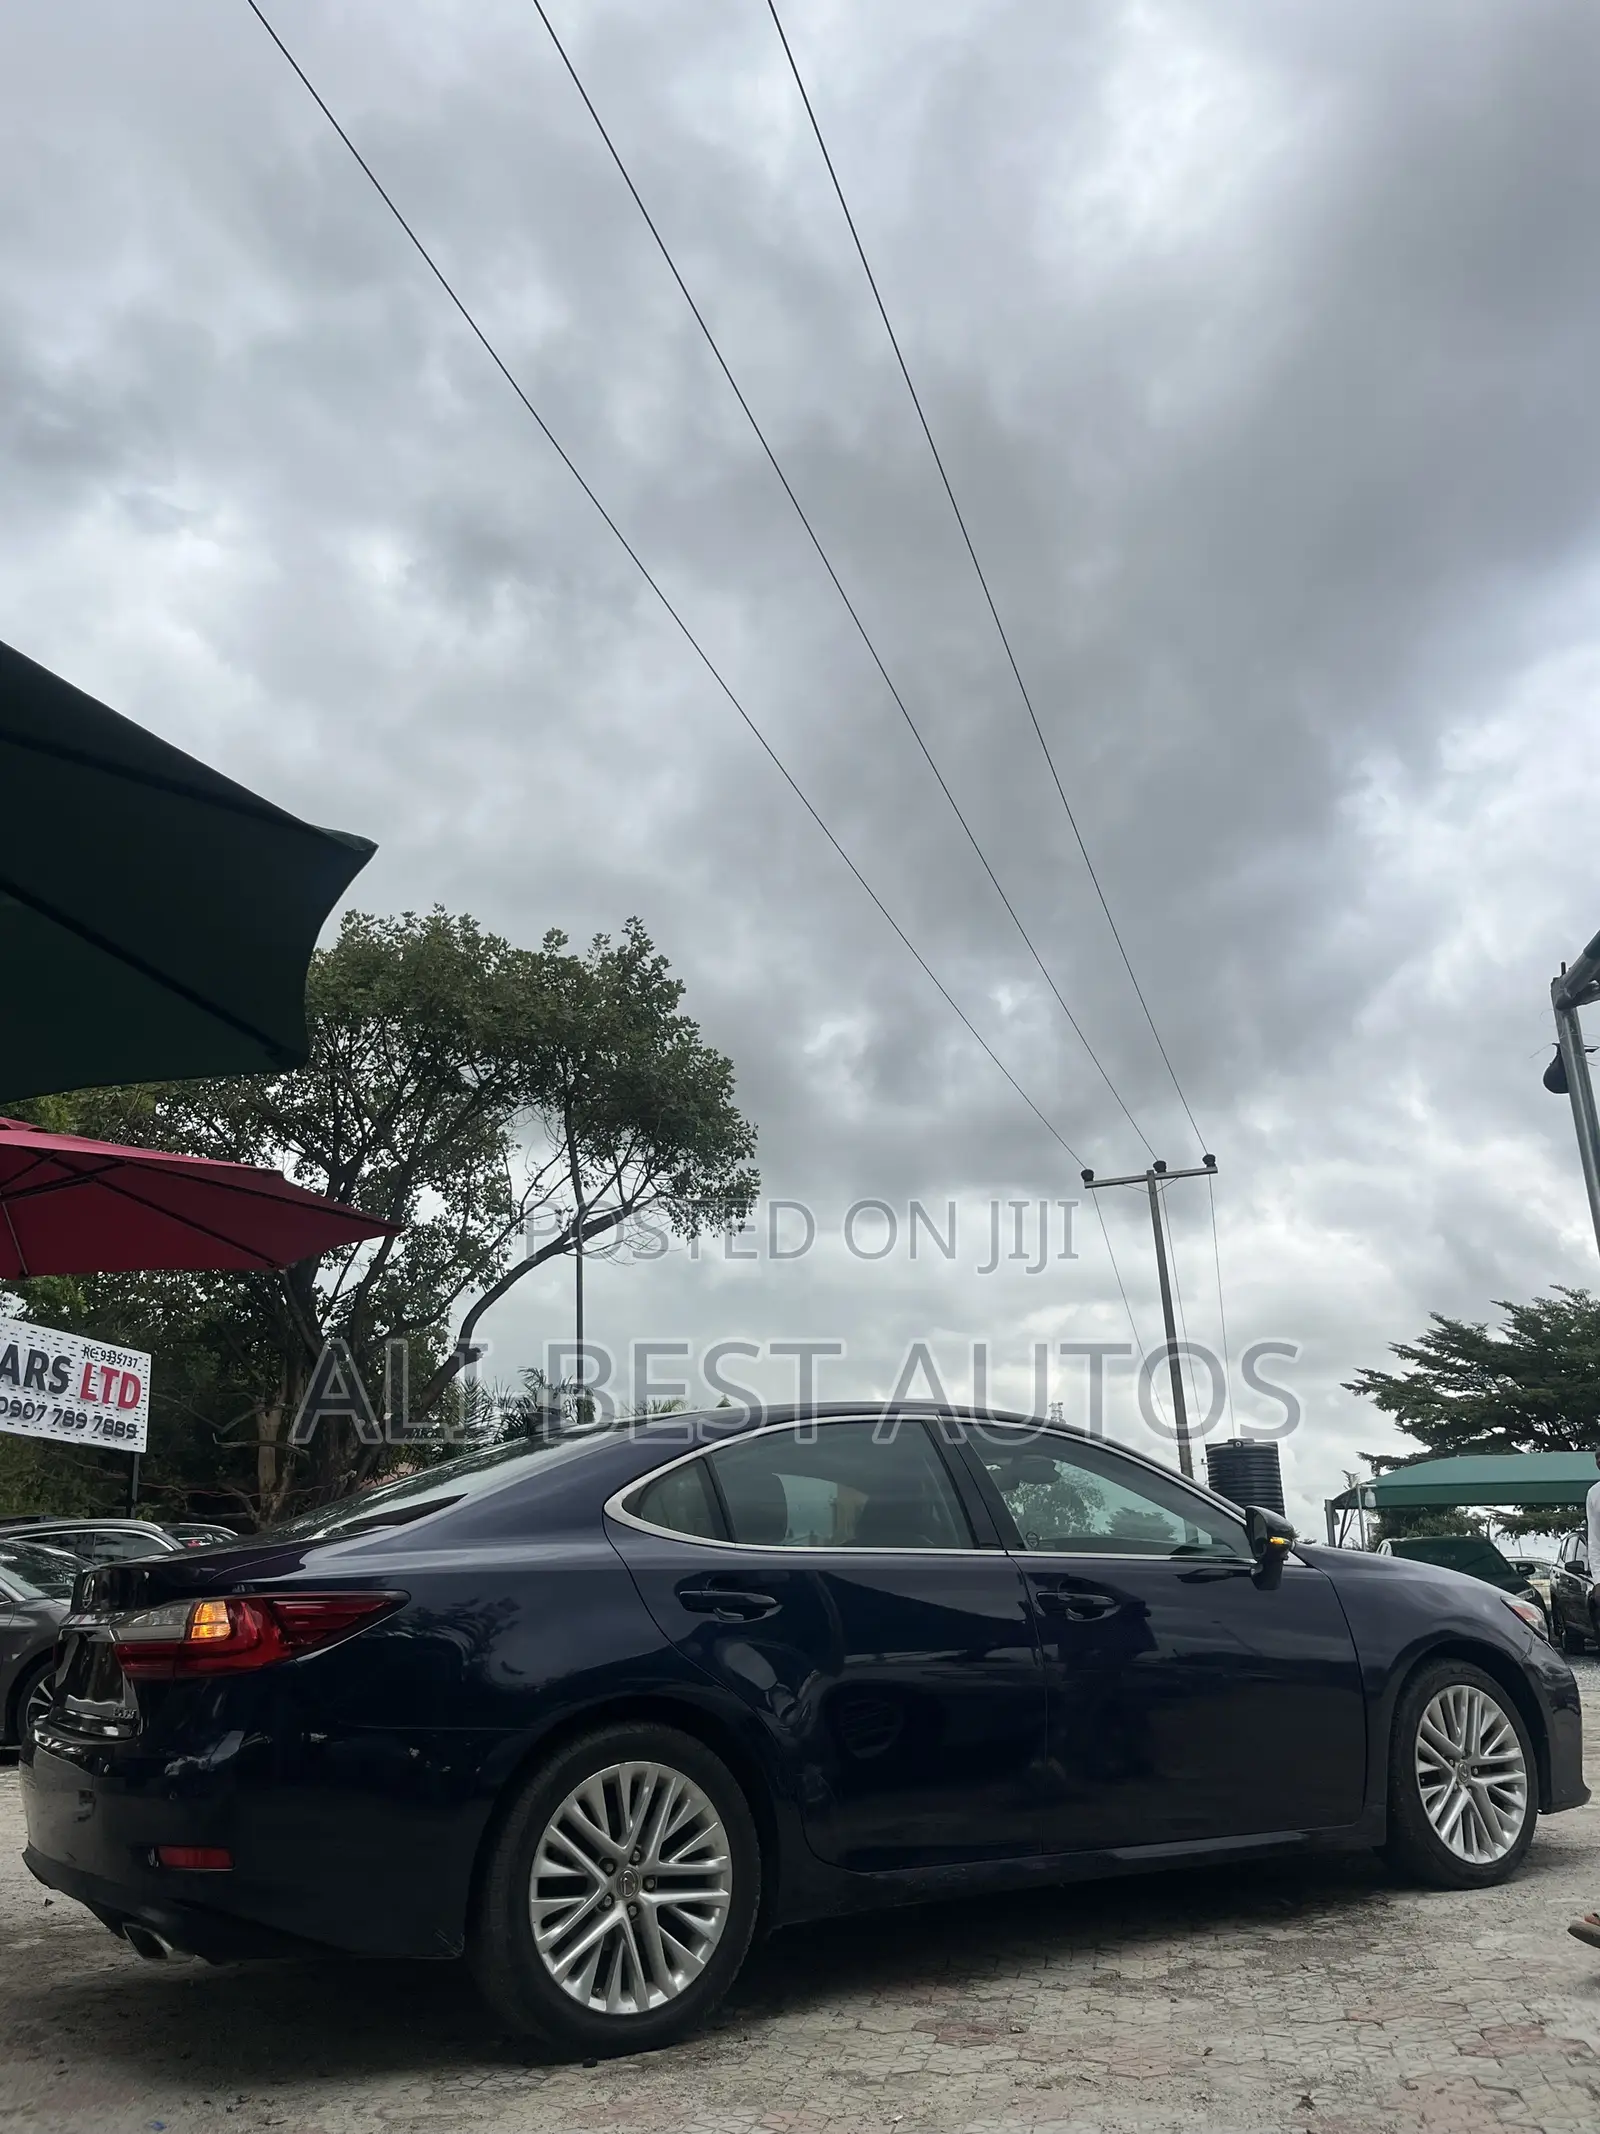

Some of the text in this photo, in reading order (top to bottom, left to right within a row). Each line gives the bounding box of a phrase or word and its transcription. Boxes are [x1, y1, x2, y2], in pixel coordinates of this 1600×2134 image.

[0, 1343, 142, 1410] ARS LTD
[52, 1407, 88, 1430] 789
[93, 1415, 138, 1440] 7889
